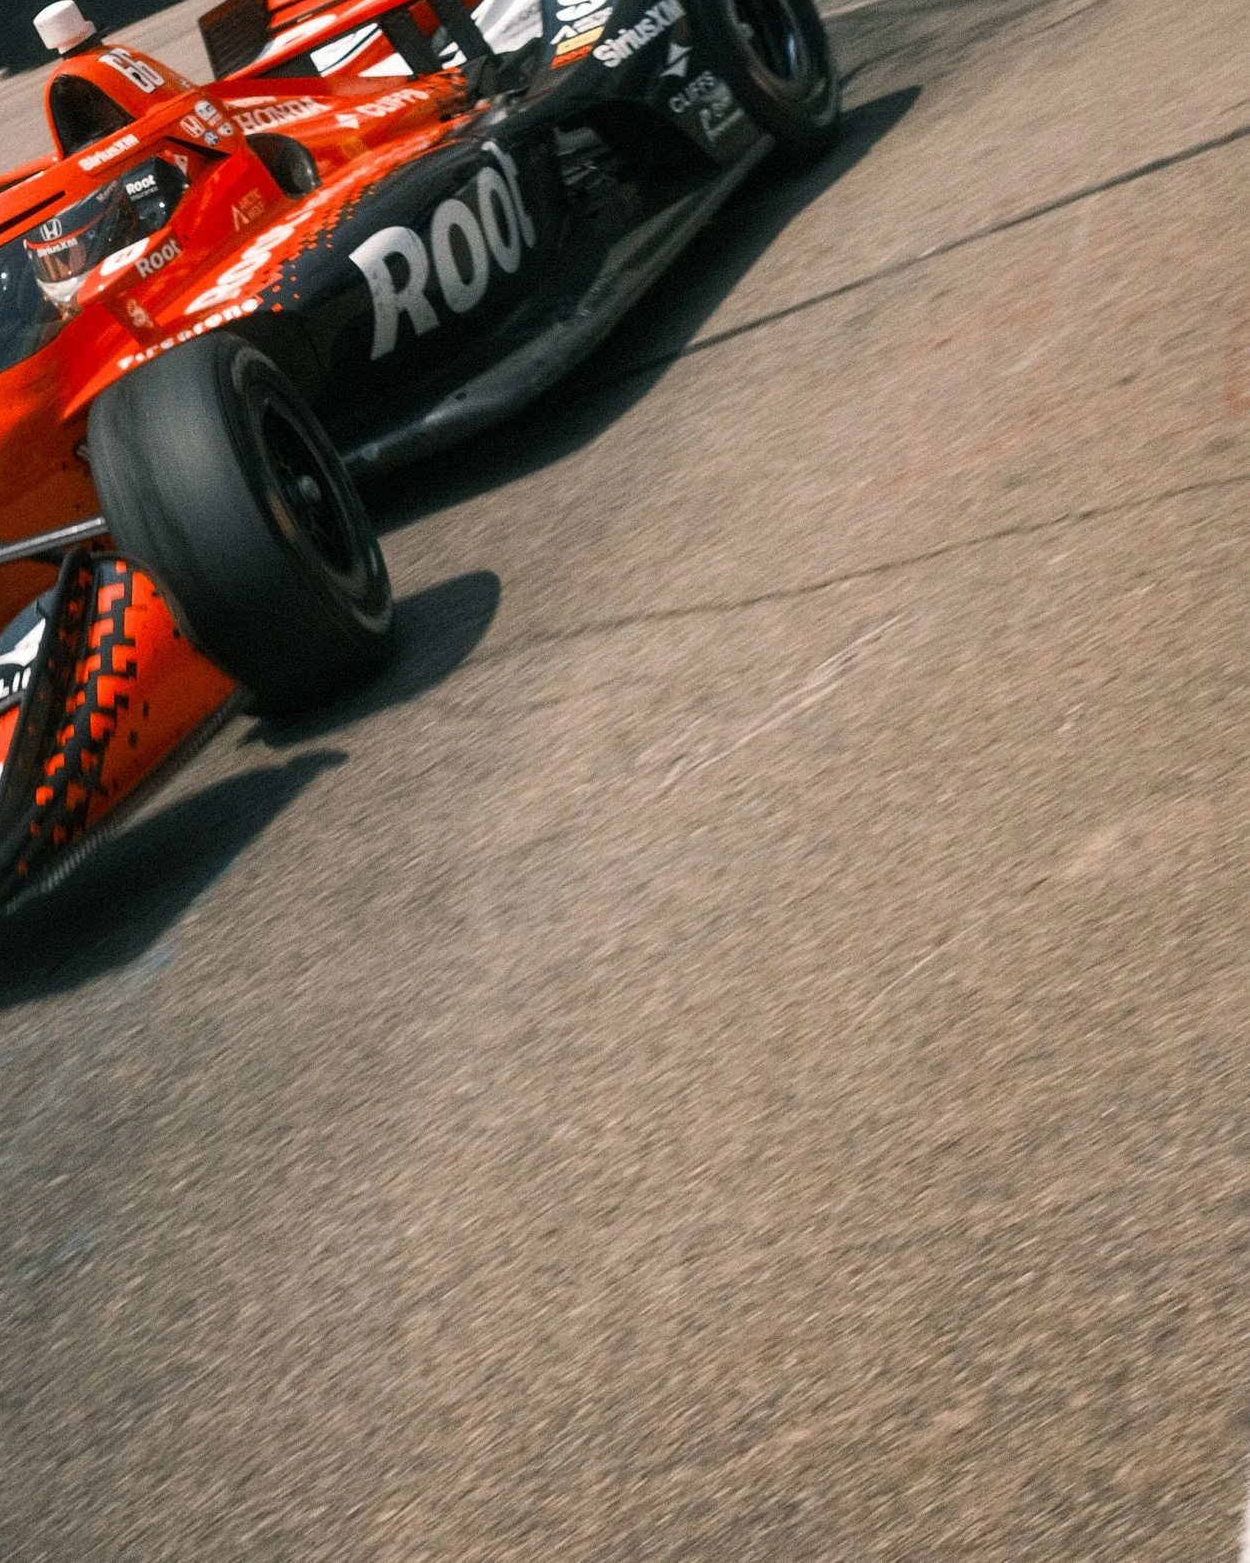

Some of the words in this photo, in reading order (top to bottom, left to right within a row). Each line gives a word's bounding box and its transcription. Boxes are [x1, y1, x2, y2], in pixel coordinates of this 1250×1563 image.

[233, 95, 333, 136] HONDA
[78, 134, 140, 171] SiriusXM
[126, 174, 156, 195] Root
[135, 238, 182, 278] Root
[349, 141, 536, 361] Root
